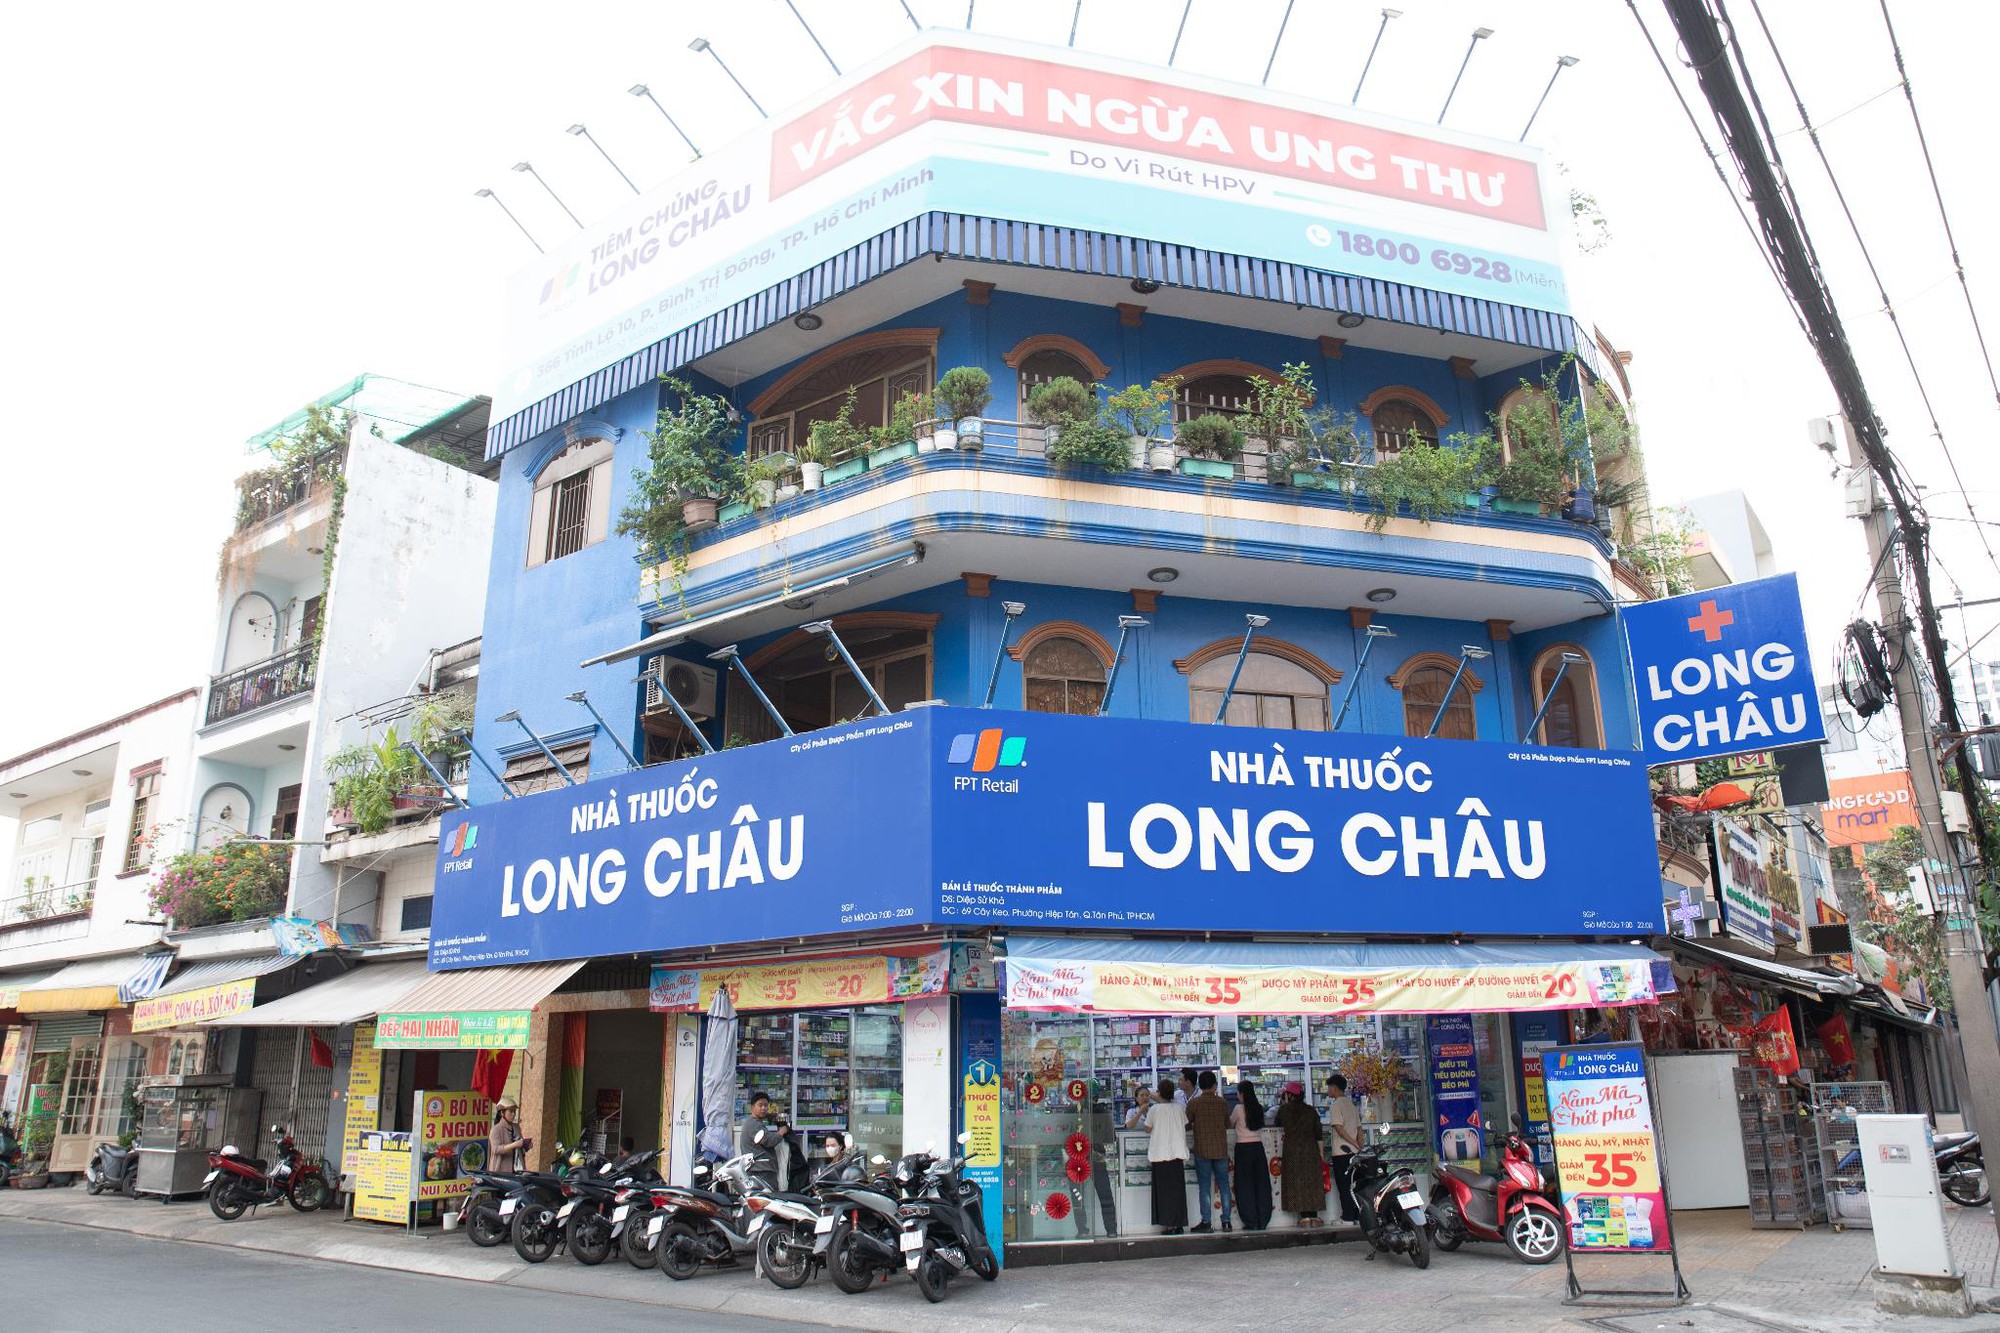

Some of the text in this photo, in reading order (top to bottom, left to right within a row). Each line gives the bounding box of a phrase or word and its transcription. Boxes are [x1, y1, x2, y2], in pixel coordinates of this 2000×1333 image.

[790, 71, 1508, 207] VẮC XIN NGỪA UNG THƯ
[1069, 149, 1257, 198] Do Vi Rút HPV
[591, 179, 720, 265] TIÊM CHỦNG
[587, 183, 752, 296] LONG CHÂU
[1337, 229, 1421, 266] 1800
[1430, 249, 1513, 284] 6928
[536, 355, 561, 377] 366
[597, 326, 615, 348] Lộ
[617, 316, 638, 339] 10,
[640, 310, 655, 328] P.
[659, 285, 695, 314] Bình
[724, 248, 776, 279] Đông,
[781, 229, 809, 251] TP.
[813, 208, 840, 237] Hồ
[844, 189, 877, 220] Chí
[881, 167, 934, 202] Minh
[1647, 642, 1795, 701] LONG
[865, 729, 876, 737] FPT
[877, 725, 893, 734] Long
[894, 720, 913, 730] Châu
[1653, 690, 1807, 752] CHÂU
[1210, 742, 1433, 793] NHÀ THUỐC
[1597, 758, 1612, 766] Long
[1613, 758, 1630, 766] Châu
[954, 776, 1018, 793] FPT Retail
[570, 766, 719, 834] NHÀ THUỐC
[1820, 789, 1909, 812] INGFOOD
[1837, 806, 1889, 829] mart
[1088, 797, 1548, 881] LONG CHÂU
[444, 861, 456, 874] FPT
[502, 804, 805, 918] LONG CHÂU
[941, 880, 1063, 895] BÁN LẺ THUỐC THÀNH PHẨM
[956, 895, 976, 906] Diệp
[896, 907, 914, 918] 22:00
[961, 907, 972, 915] 69
[973, 907, 991, 917] Cây
[1012, 908, 1043, 919] Phường
[1045, 908, 1063, 920] Hiệp
[1019, 967, 1084, 986] Năm Mã
[1100, 973, 1131, 986] HÀNG
[1174, 975, 1201, 990] NHẬT
[1262, 978, 1290, 992] DƯỢC
[1310, 975, 1338, 989] PHẨM
[1417, 977, 1432, 987] ĐO
[1434, 974, 1461, 988] HUYẾT
[1478, 973, 1511, 986] ĐƯỜNG
[1160, 990, 1200, 1002] GIẢM ĐẾN
[1204, 976, 1248, 1005] 35%
[1323, 992, 1338, 1003] ĐẾN
[401, 1018, 422, 1039] HAI
[1577, 1051, 1617, 1062] NHÀ THUỐC
[1578, 1064, 1606, 1075] LONG
[1609, 1060, 1638, 1073] CHÂU
[1030, 1083, 1082, 1099] 2 6
[1558, 1085, 1643, 1111] Năm Mã
[973, 1114, 992, 1122] TOA
[1571, 1102, 1637, 1127] bứt phá
[425, 1120, 489, 1139] 3 NGON
[1555, 1137, 1582, 1148] HÀNG
[1603, 1136, 1620, 1149] MỸ,
[1622, 1135, 1651, 1150] NHẬT
[1559, 1157, 1584, 1170] GIẢM
[1584, 1149, 1647, 1188] 35%
[1566, 1170, 1585, 1182] ĐẾN
[421, 1184, 440, 1196] NUI
